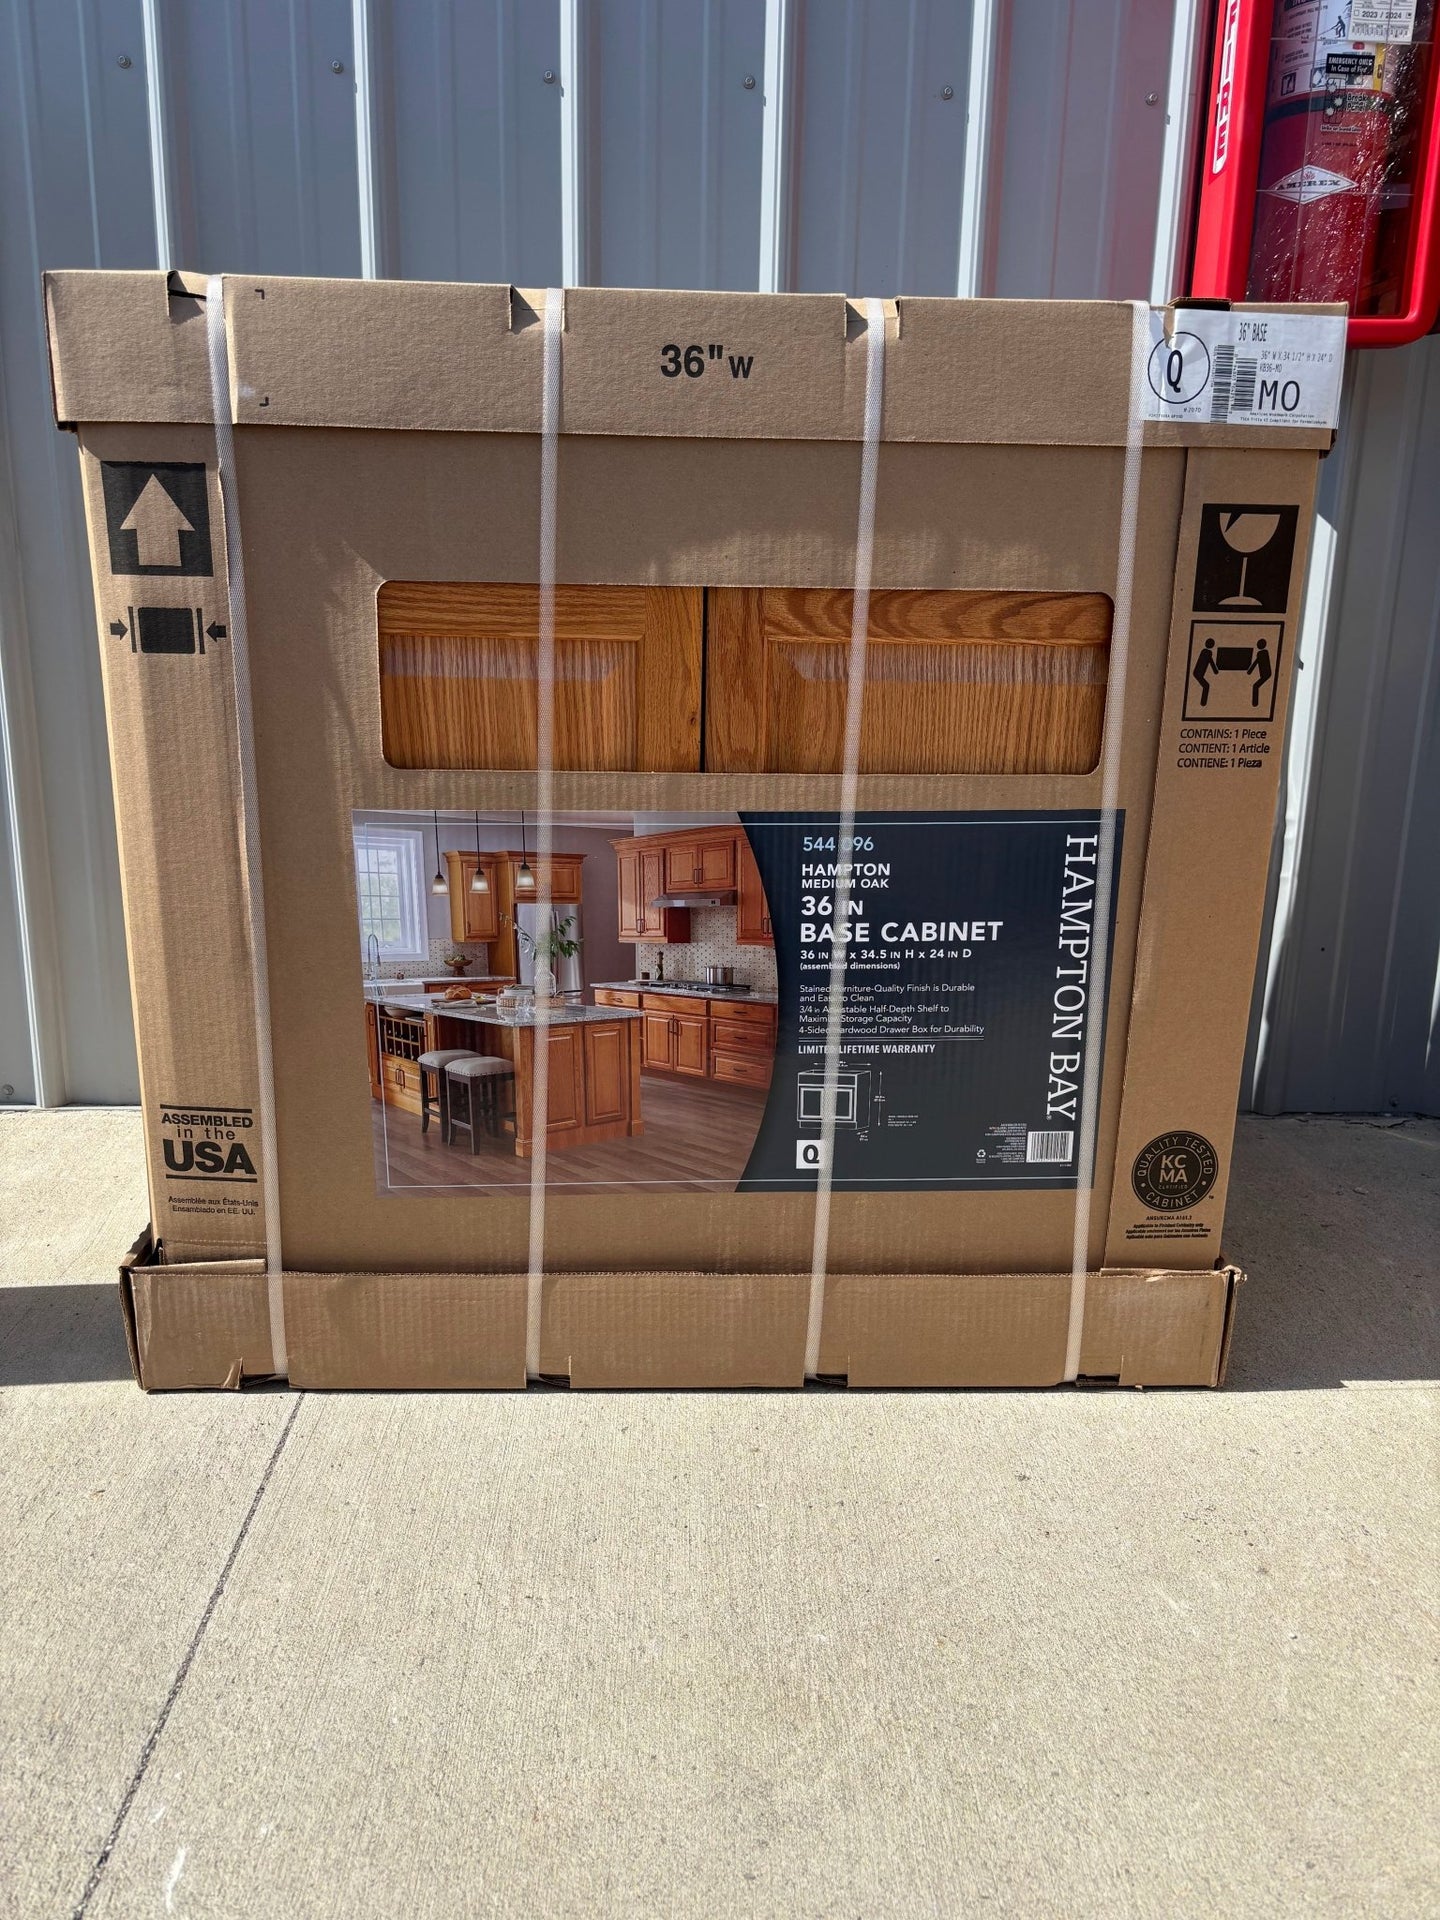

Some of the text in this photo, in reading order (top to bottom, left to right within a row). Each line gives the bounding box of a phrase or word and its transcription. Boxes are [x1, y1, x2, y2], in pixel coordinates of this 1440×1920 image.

[1362, 11, 1378, 19] 2023
[1385, 11, 1402, 20] 2024
[1328, 57, 1357, 66] EMERGENCY
[1277, 180, 1340, 190] AMEREX
[1239, 322, 1268, 342] 36" BASE
[1283, 351, 1290, 361] 34
[1167, 349, 1182, 393] Q
[1258, 380, 1301, 411] MO
[1180, 729, 1267, 739] CONTAINS: 1 Piece
[1178, 743, 1270, 753] CONTIENT: 1 Article
[1177, 758, 1263, 768] CONTIENE: 1 Pieza
[803, 836, 836, 851] 544
[801, 863, 890, 877] HAMPTON
[801, 878, 889, 889] MEDIUM OAK
[801, 895, 833, 916] 36
[800, 921, 1004, 942] BASE CABINET
[800, 950, 815, 959] 36
[818, 952, 829, 960] IN
[860, 949, 887, 959] 34.5
[905, 949, 914, 959] H
[918, 951, 925, 959] x
[929, 949, 944, 959] 24
[962, 949, 972, 958] D
[800, 961, 900, 971] (assembd dimensions)
[1047, 834, 1098, 1121] HAMPTON BAY
[799, 983, 975, 994] Stained rniture-Quality Finish is Durable
[799, 994, 815, 1002] and
[818, 994, 837, 1004] Ea
[850, 993, 875, 1002] Clean
[799, 1005, 813, 1014] 3/4
[822, 1004, 867, 1014] Astable
[869, 1004, 915, 1015] Half-Depth
[917, 1004, 938, 1013] Shelf
[940, 1004, 950, 1013] to
[841, 1014, 874, 1025] Storage
[875, 1014, 912, 1024] Capacity
[832, 1025, 877, 1034] ardwood
[879, 1025, 910, 1034] Drawer
[912, 1025, 928, 1034] Box
[930, 1025, 942, 1033] for
[944, 1024, 985, 1035] Durability
[798, 1044, 936, 1054] LIMITE LIFETIME WARRANTY
[161, 1112, 254, 1129] ASSEMBLED
[177, 1125, 236, 1140] in the
[162, 1138, 258, 1175] USA
[1137, 1136, 1213, 1177] QUALITY TESTED
[1161, 1154, 1187, 1169] KC
[1159, 1169, 1188, 1183] MA
[222, 1197, 259, 1207] États-Unis
[1145, 1189, 1200, 1208] CABINET
[172, 1205, 215, 1213] Ensamblado
